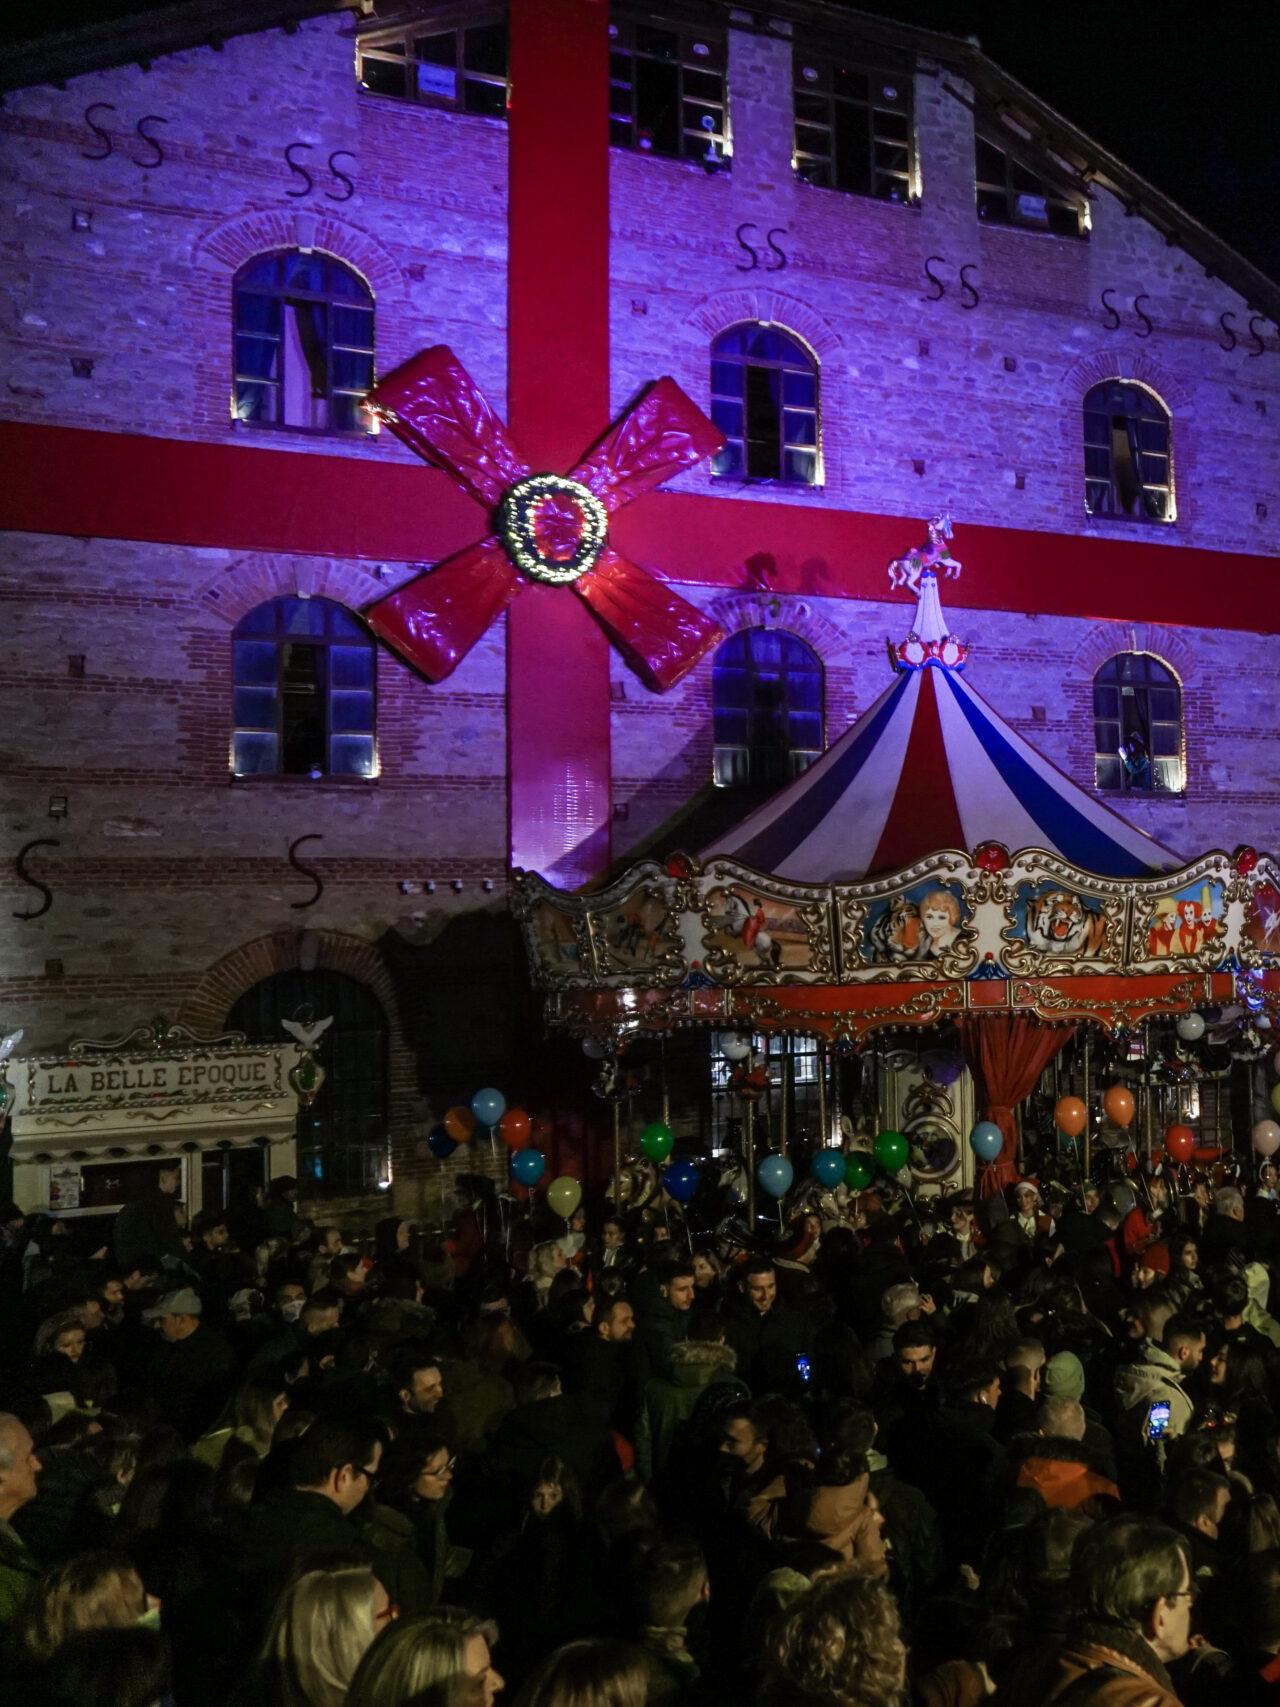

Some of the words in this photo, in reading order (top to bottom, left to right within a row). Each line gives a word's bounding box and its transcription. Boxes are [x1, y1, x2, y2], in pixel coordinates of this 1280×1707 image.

[47, 1073, 79, 1094] LA
[91, 1068, 167, 1092] BELLE
[178, 1062, 266, 1086] EPOQUE
